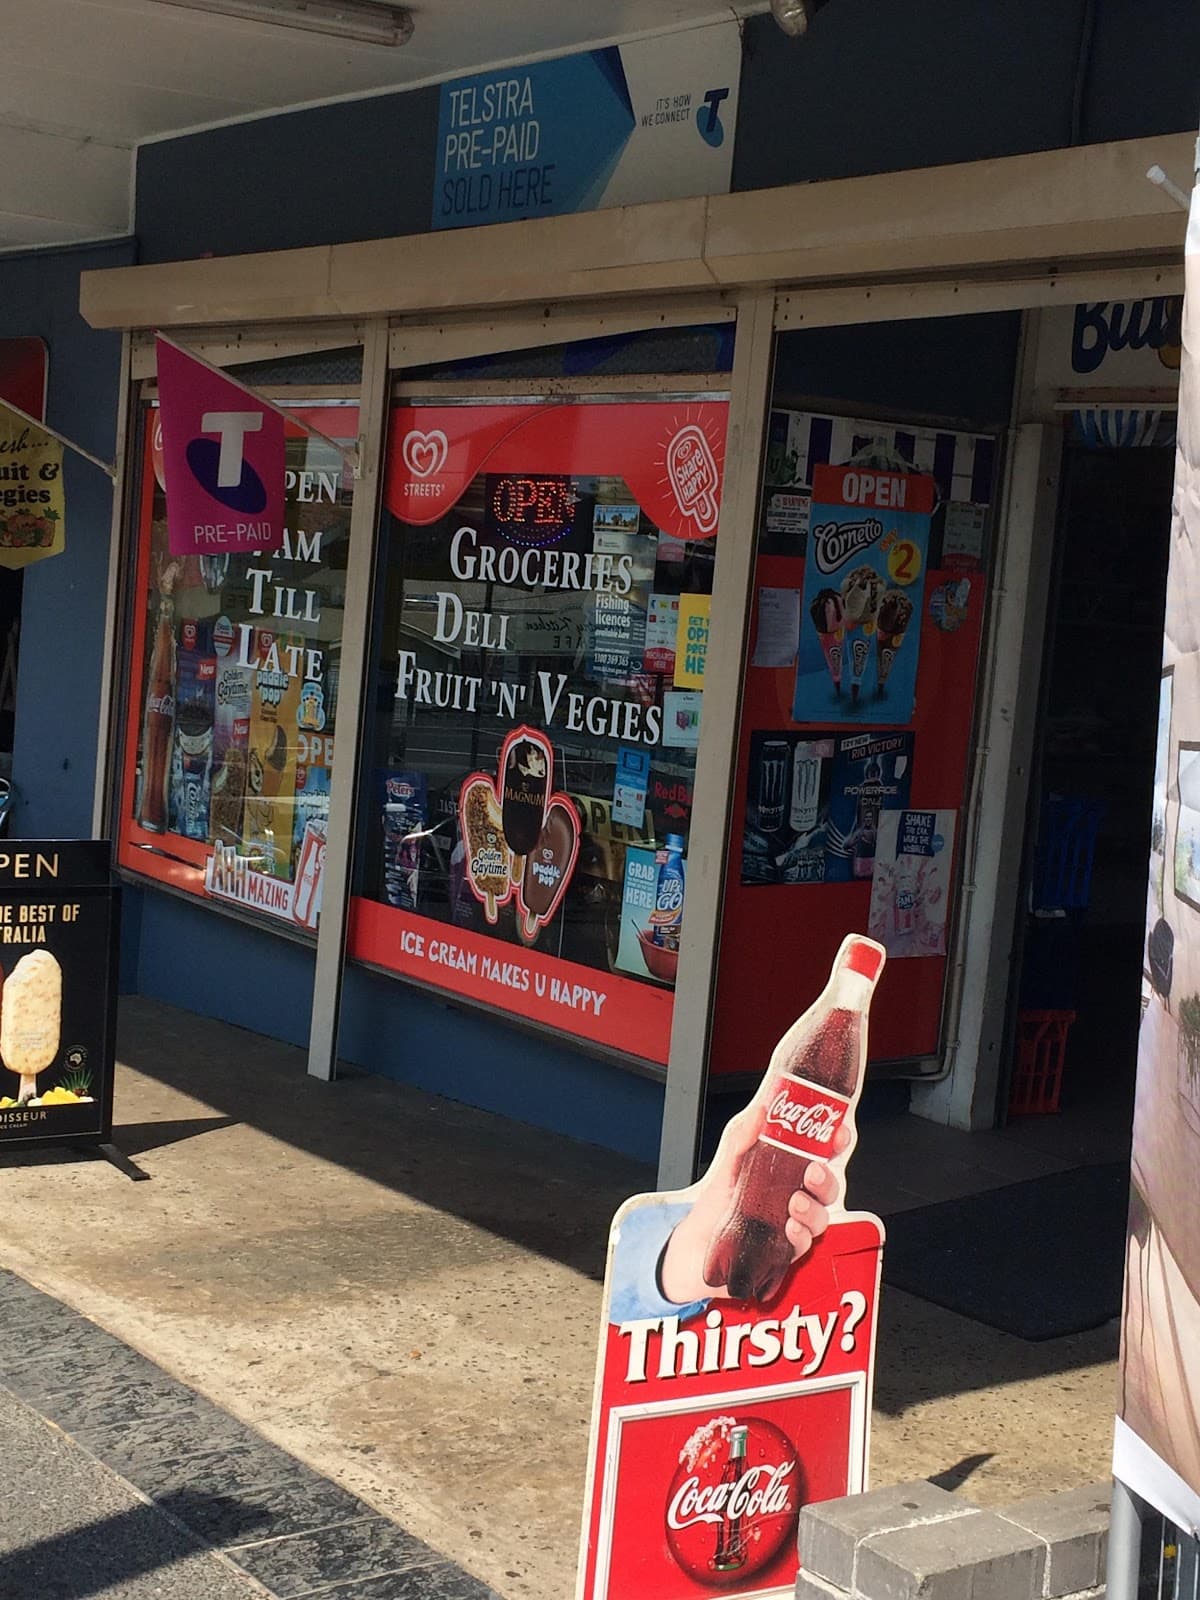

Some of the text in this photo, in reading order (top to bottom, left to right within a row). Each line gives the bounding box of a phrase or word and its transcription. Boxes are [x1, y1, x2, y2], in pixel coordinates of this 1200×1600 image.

[450, 76, 533, 129] TELSTRA
[656, 94, 691, 110] IT'S HOW
[641, 108, 690, 127] WE CONNECT
[444, 120, 539, 173] PRE-PAID
[441, 164, 555, 216] SOLD HERE
[39, 463, 59, 480] &
[0, 485, 50, 507] gies
[284, 471, 339, 504] PEN
[404, 482, 442, 497] STREETS
[842, 472, 906, 507] OPEN
[493, 478, 580, 524] OPEN
[194, 522, 272, 546] PRE-PAID
[814, 519, 883, 575] Cornetto
[450, 527, 634, 595] GROCERIES
[895, 543, 914, 578] 2
[246, 568, 321, 624] TILL
[596, 594, 630, 615] Fishing
[433, 591, 509, 650] DELI
[595, 610, 631, 627] licences
[236, 623, 324, 682] LATE
[394, 649, 482, 713] FRUIT
[538, 672, 662, 746] VEGIES
[297, 734, 337, 767] OPE
[852, 747, 866, 760] RIO
[868, 736, 904, 755] VICTORY
[505, 785, 545, 808] MAGNUM
[655, 781, 677, 799] Red
[904, 813, 933, 828] SHAKE
[479, 848, 502, 862] Golden
[471, 859, 508, 879] Gaytime
[628, 861, 655, 882] GRAB
[625, 887, 653, 909] HERE
[656, 893, 683, 911] GO
[19, 904, 56, 924] BEST
[62, 903, 80, 922] OF
[0, 924, 47, 944] RALIA
[401, 930, 608, 1019] ICE CREAM MAKES U HAPPY
[0, 1110, 48, 1123] ISSEUR
[767, 1090, 842, 1143] Coca-Cola
[618, 1291, 867, 1382] Thirsty?
[667, 1461, 796, 1530] Coca-Cola
